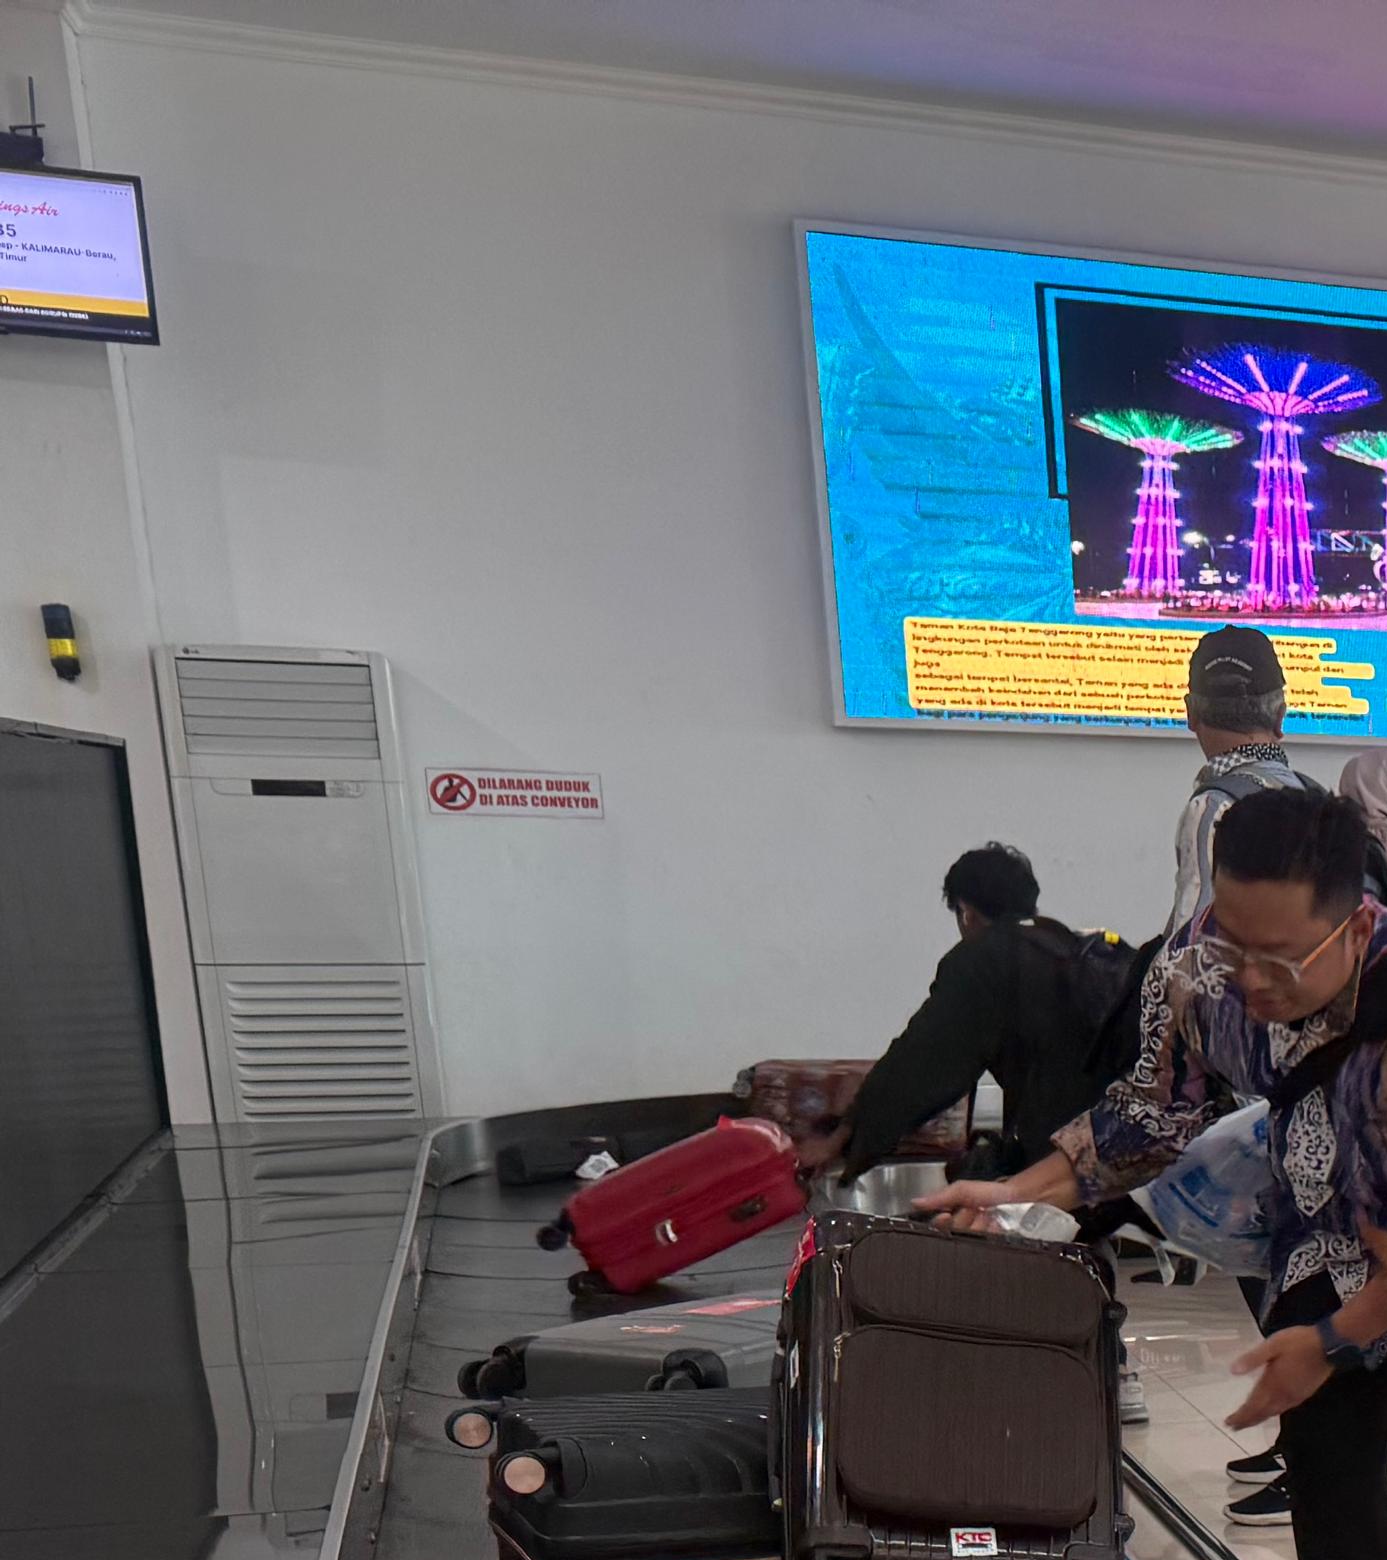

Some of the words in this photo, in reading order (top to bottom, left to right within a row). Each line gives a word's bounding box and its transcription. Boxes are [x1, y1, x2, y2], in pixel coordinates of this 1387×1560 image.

[30, 201, 59, 217] Air
[477, 777, 542, 792] DILARANG
[545, 779, 592, 793] DUDUK
[479, 793, 494, 807] DI
[496, 794, 529, 808] ATAS
[531, 795, 600, 809] CONVEYOR
